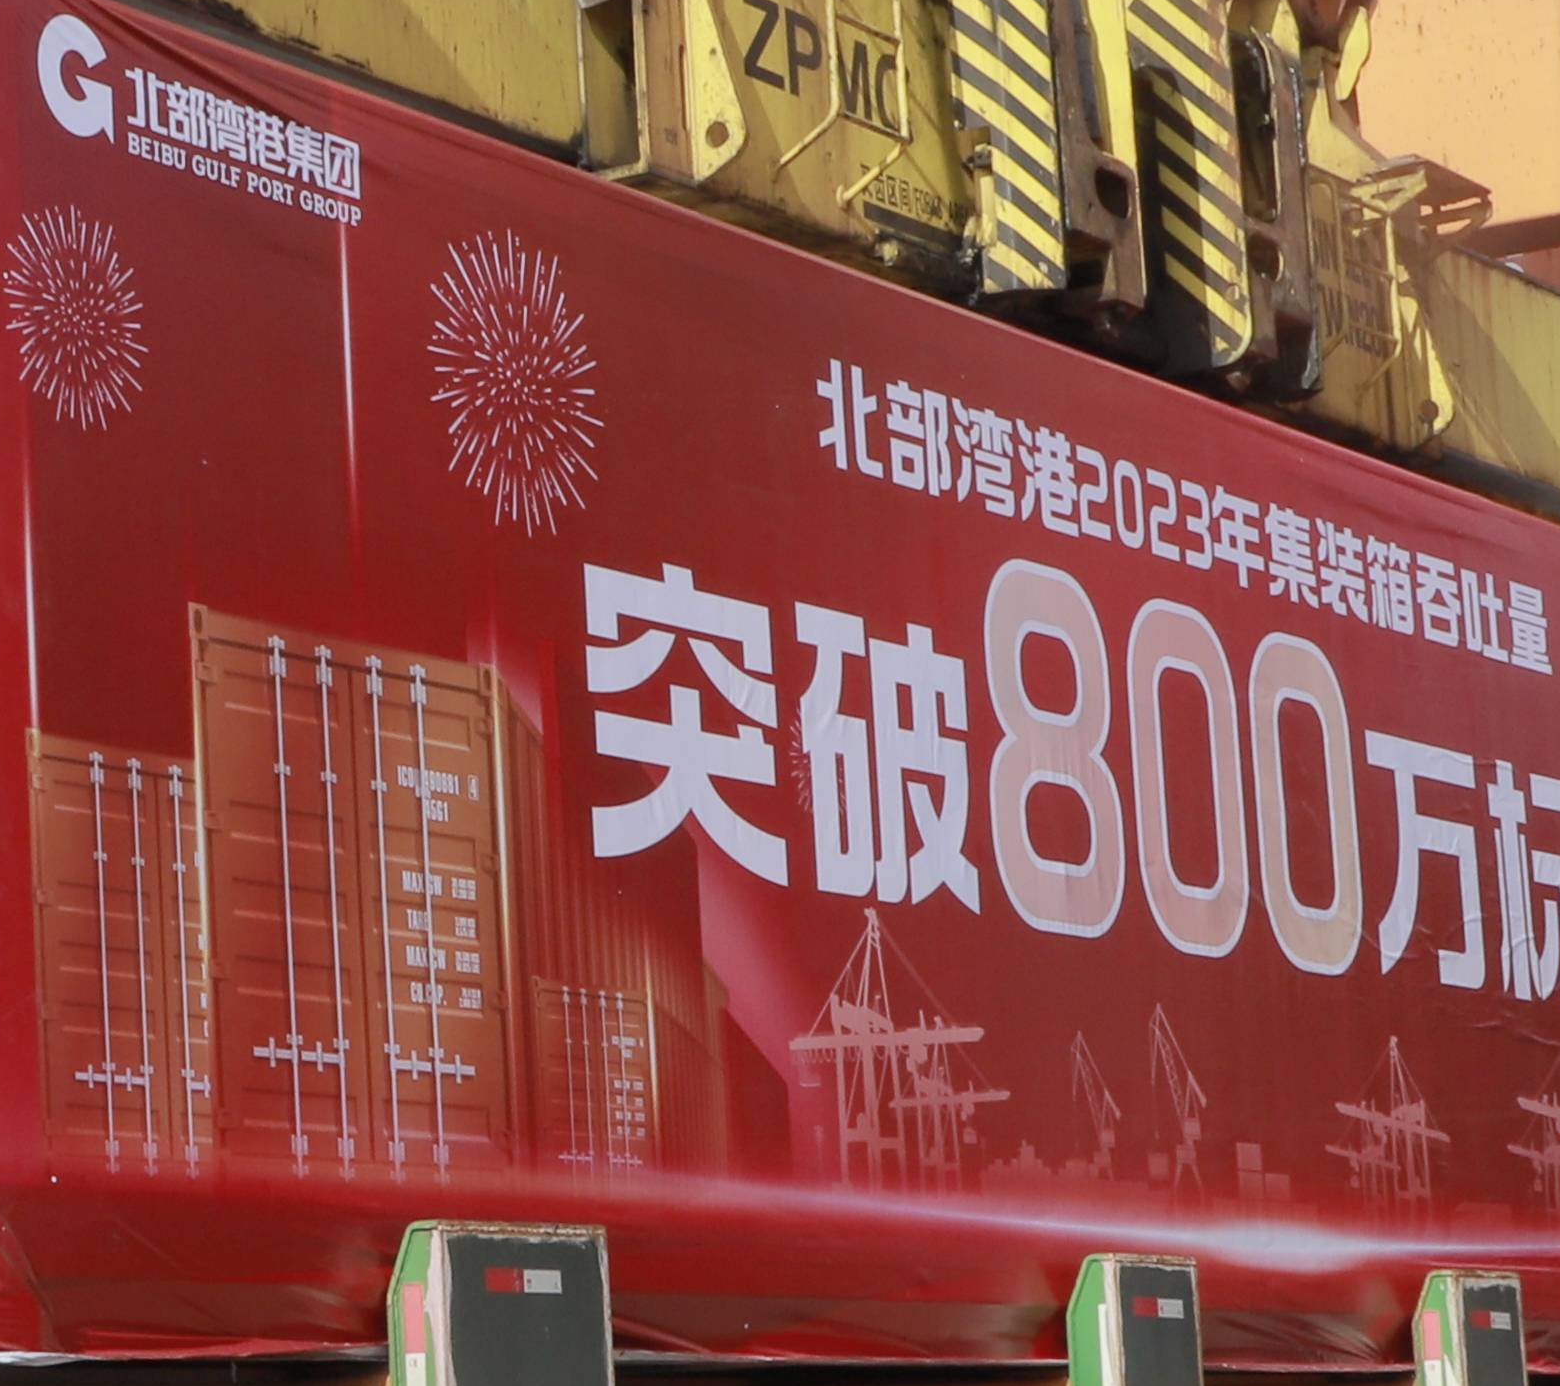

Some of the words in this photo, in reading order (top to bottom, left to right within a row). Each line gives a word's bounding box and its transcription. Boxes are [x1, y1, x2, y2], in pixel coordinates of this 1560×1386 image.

[125, 67, 362, 200] 北部湾港集团
[127, 131, 186, 170] BEIBU
[191, 154, 241, 188] GULF
[246, 170, 294, 206] PORT
[298, 189, 362, 226] GROUP
[815, 357, 1553, 675] 北部湾港2023年集装箱吞吐量
